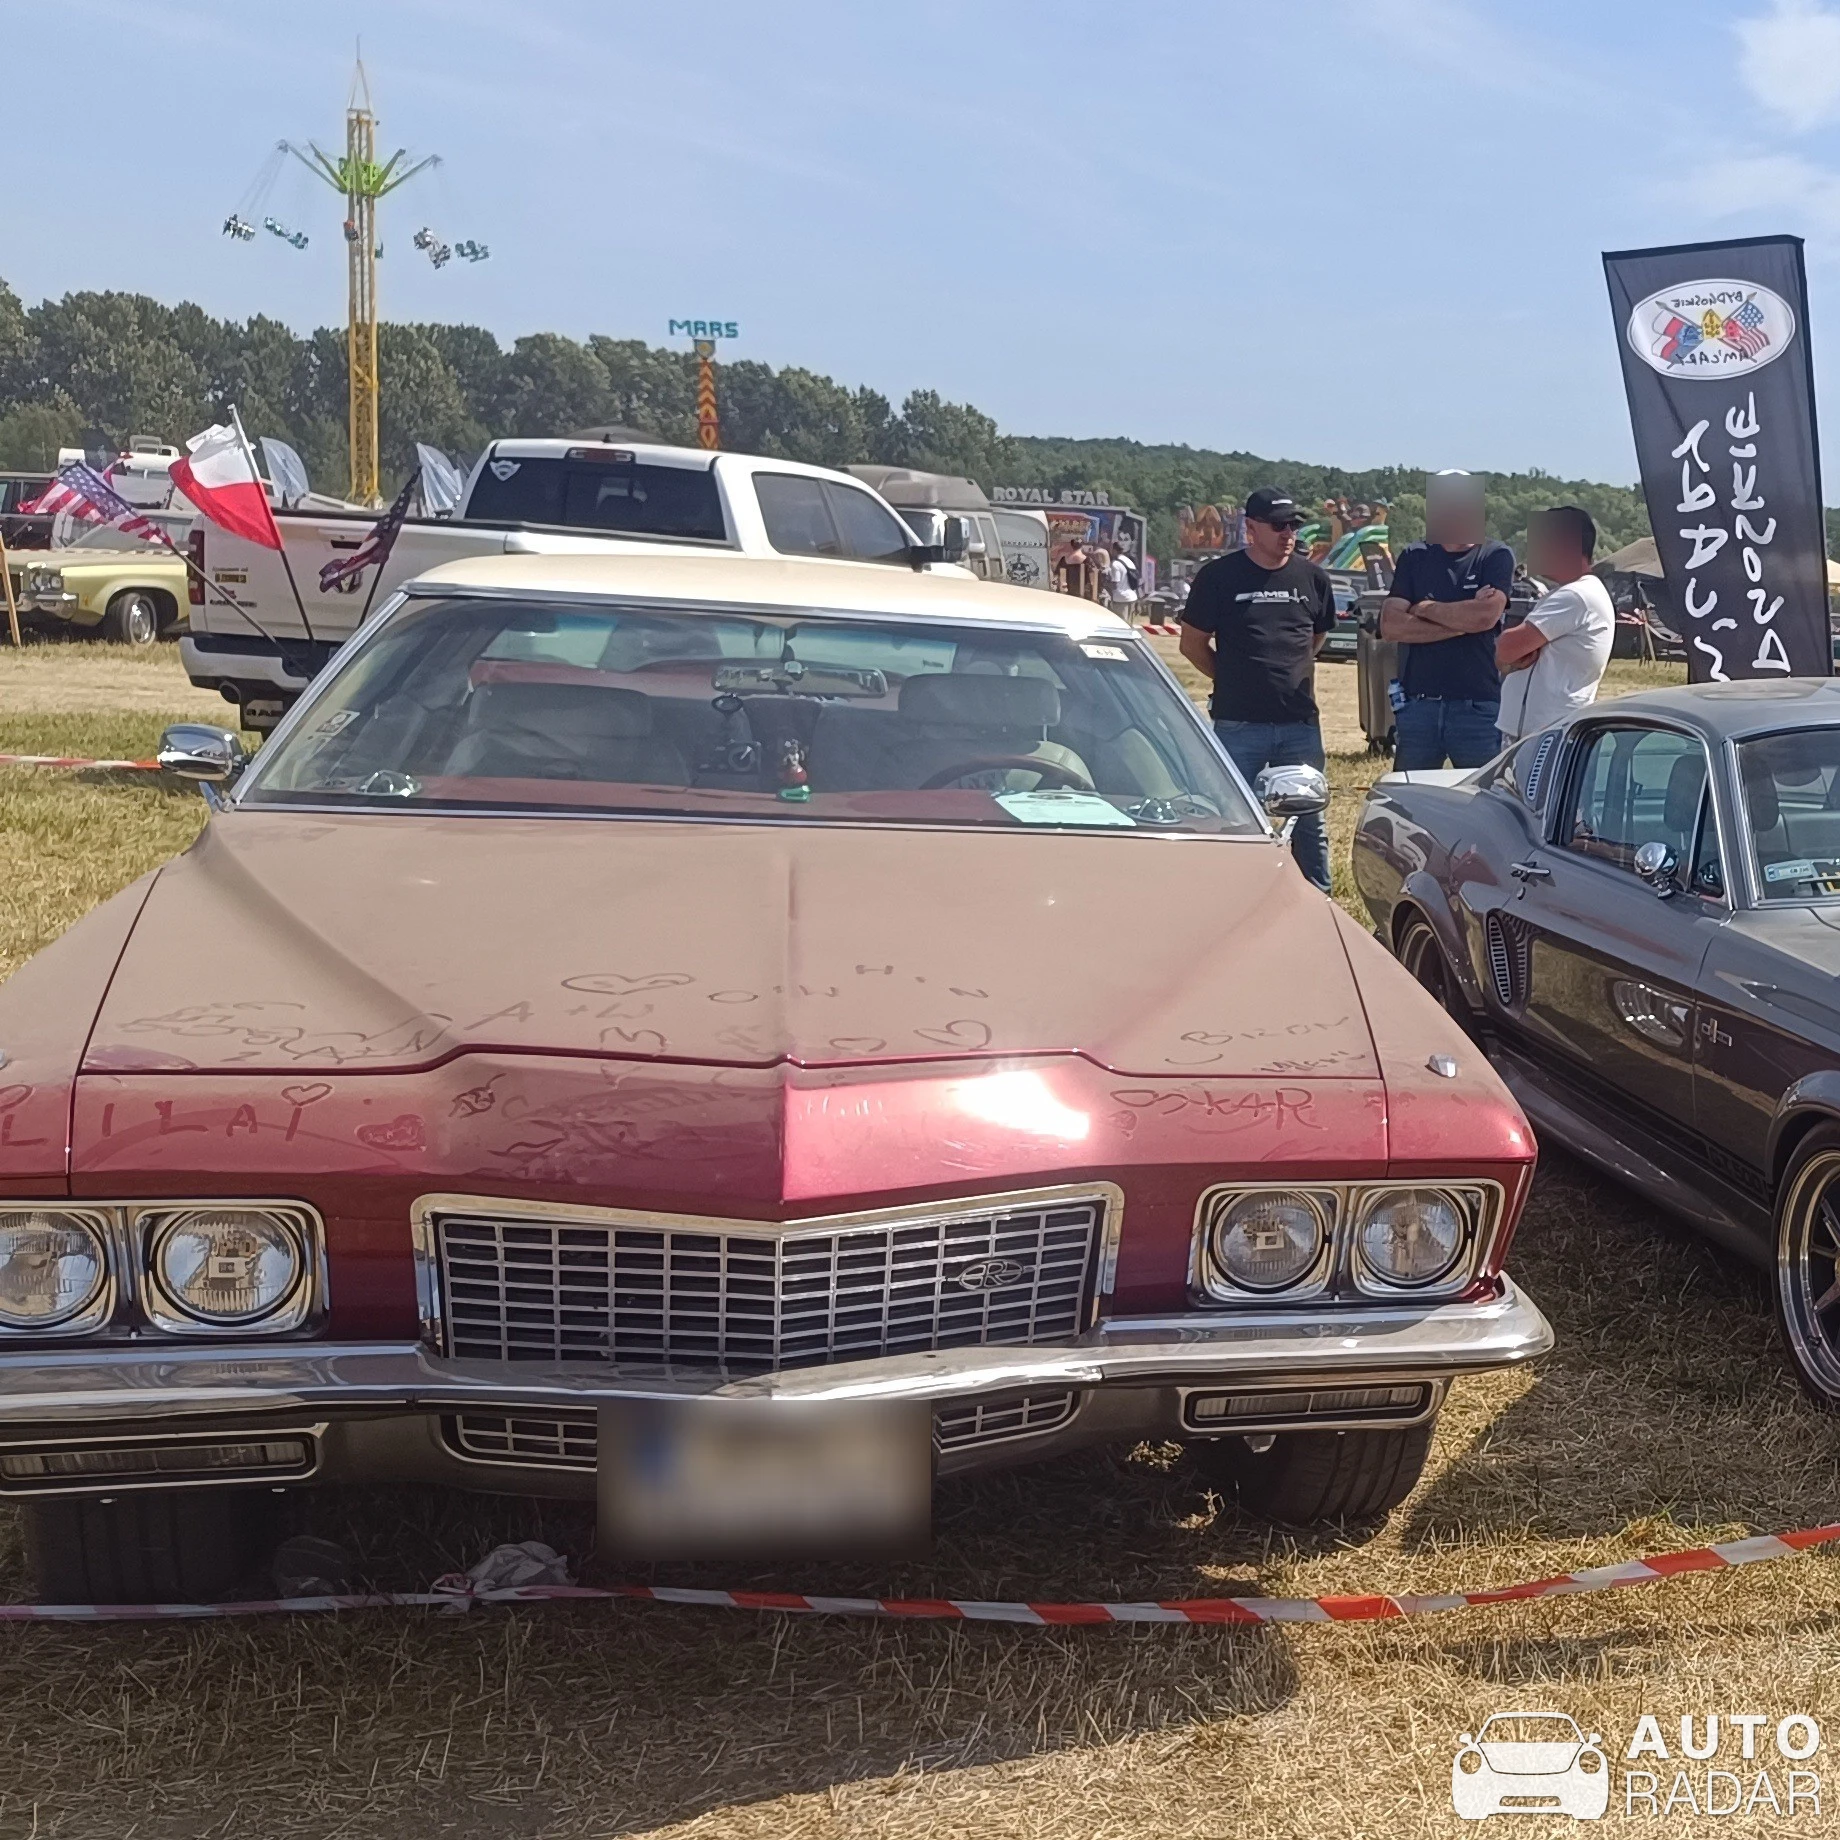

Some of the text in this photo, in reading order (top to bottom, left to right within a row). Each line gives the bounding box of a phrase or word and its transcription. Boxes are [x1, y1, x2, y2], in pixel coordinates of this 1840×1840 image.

[668, 318, 739, 339] MARS
[993, 486, 1110, 506] ROYAL STAR
